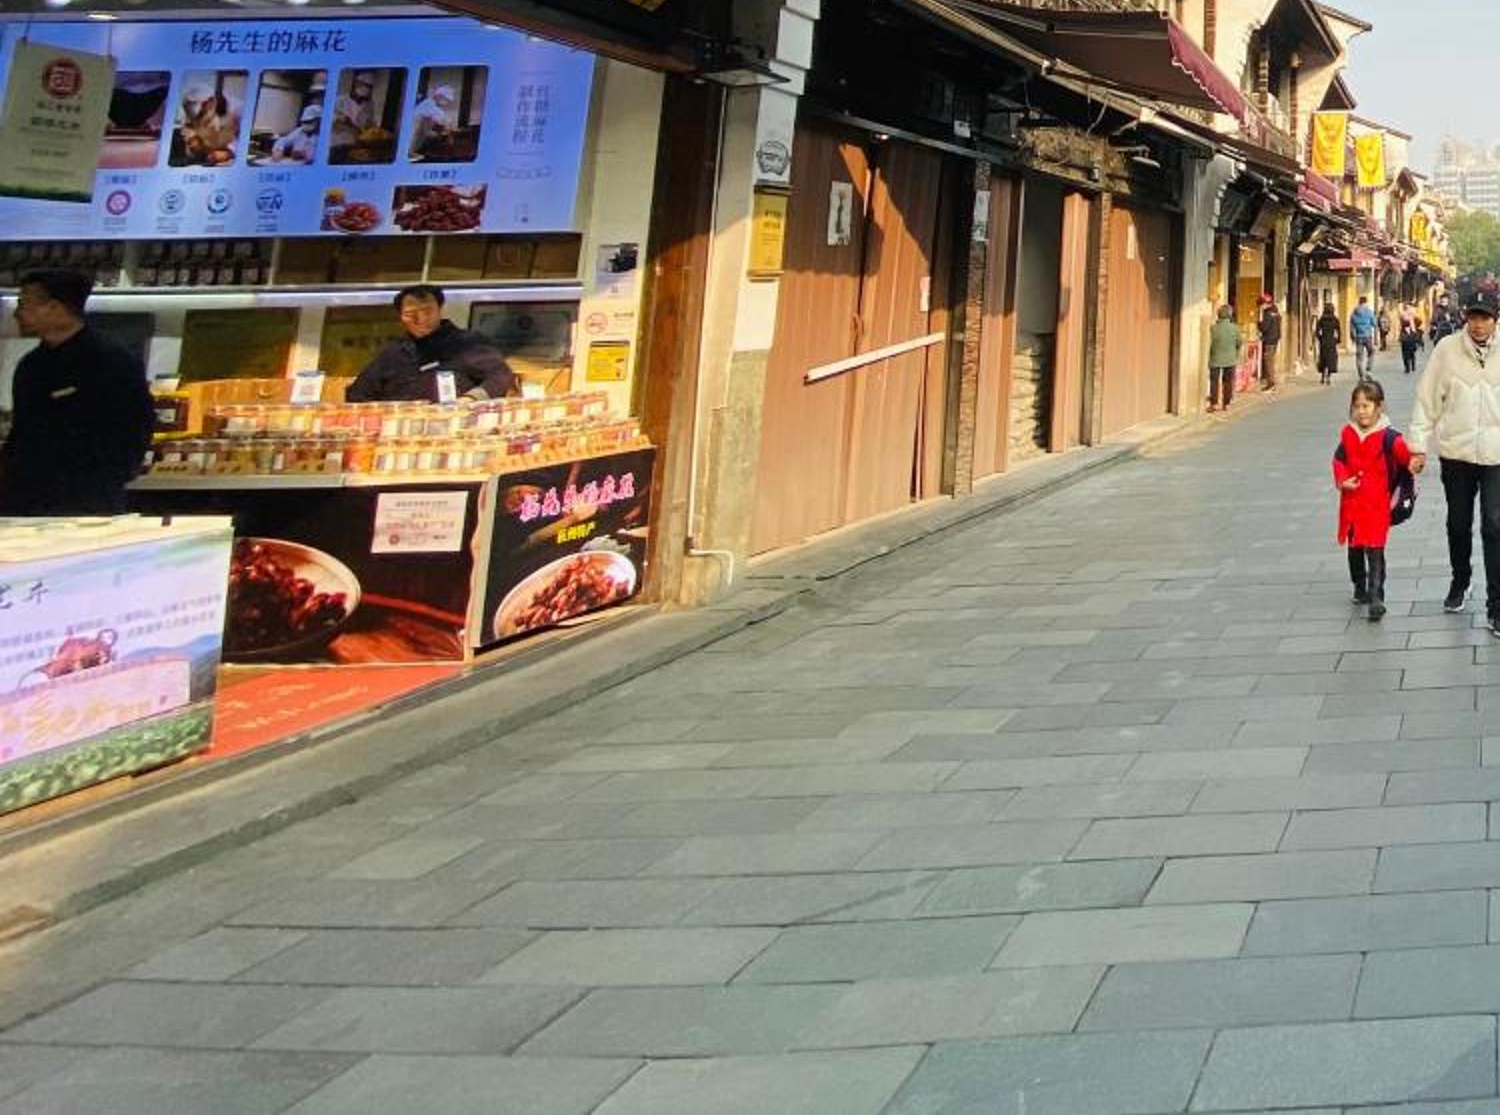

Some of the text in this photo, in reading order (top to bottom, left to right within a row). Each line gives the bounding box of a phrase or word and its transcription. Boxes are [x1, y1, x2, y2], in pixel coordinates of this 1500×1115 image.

[190, 30, 347, 54] 杨先生的麻花
